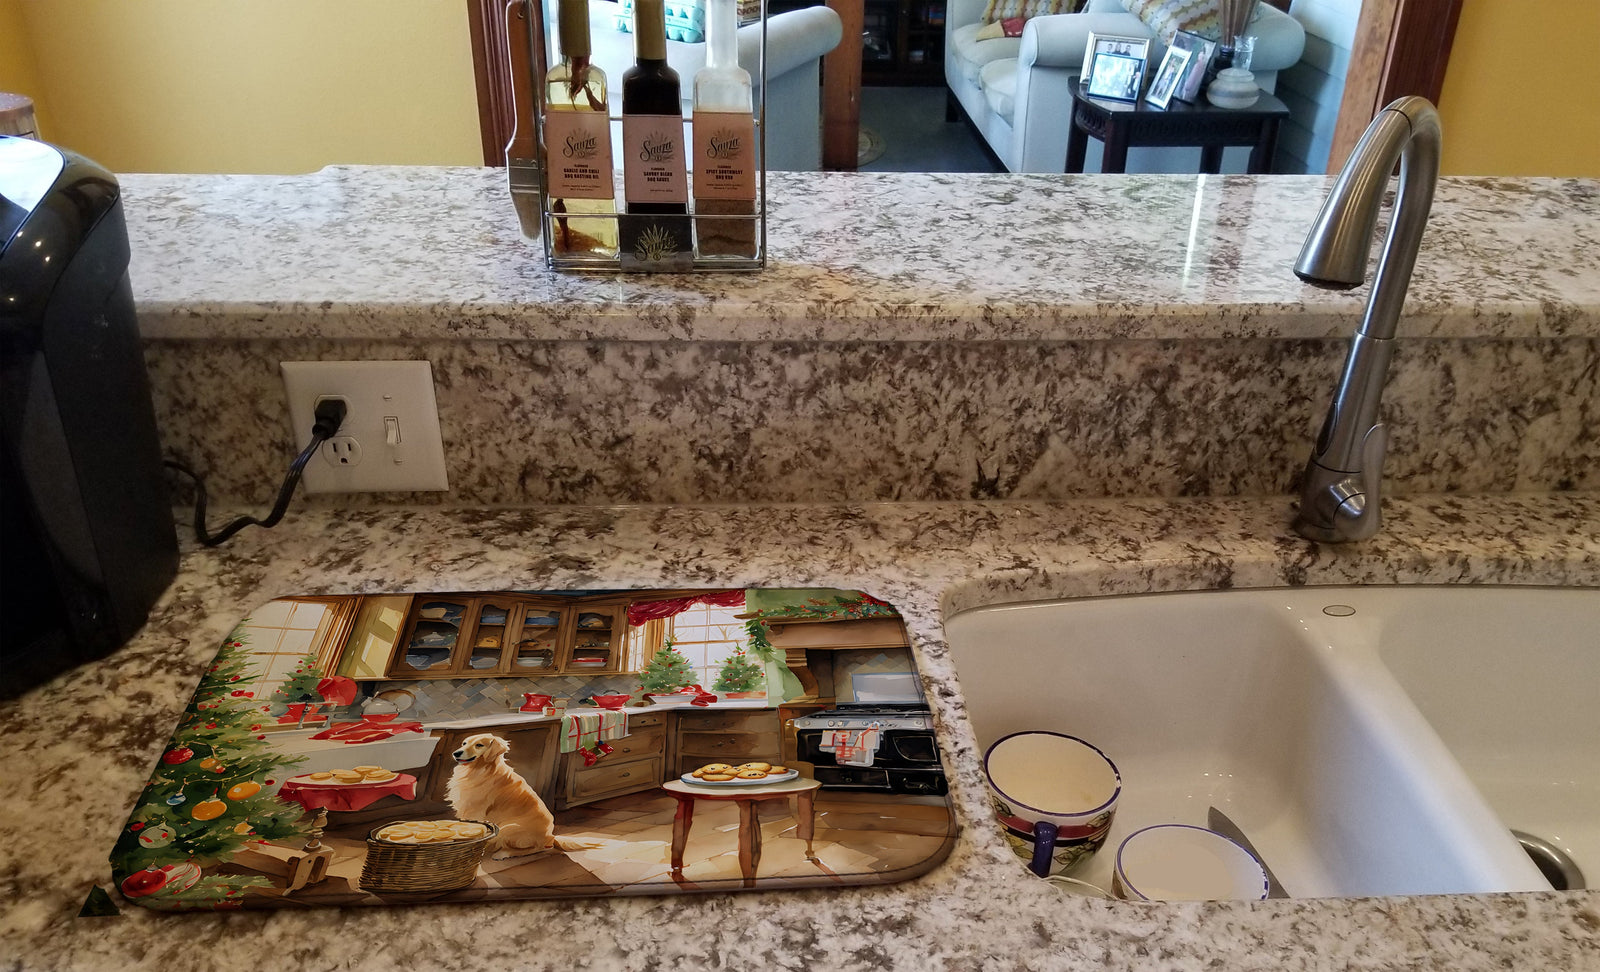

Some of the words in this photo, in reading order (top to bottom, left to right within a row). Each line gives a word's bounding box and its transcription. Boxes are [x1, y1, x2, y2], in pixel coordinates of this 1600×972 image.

[562, 136, 597, 158] Sauza
[640, 140, 673, 162] Sauza
[706, 136, 740, 159] Sauza
